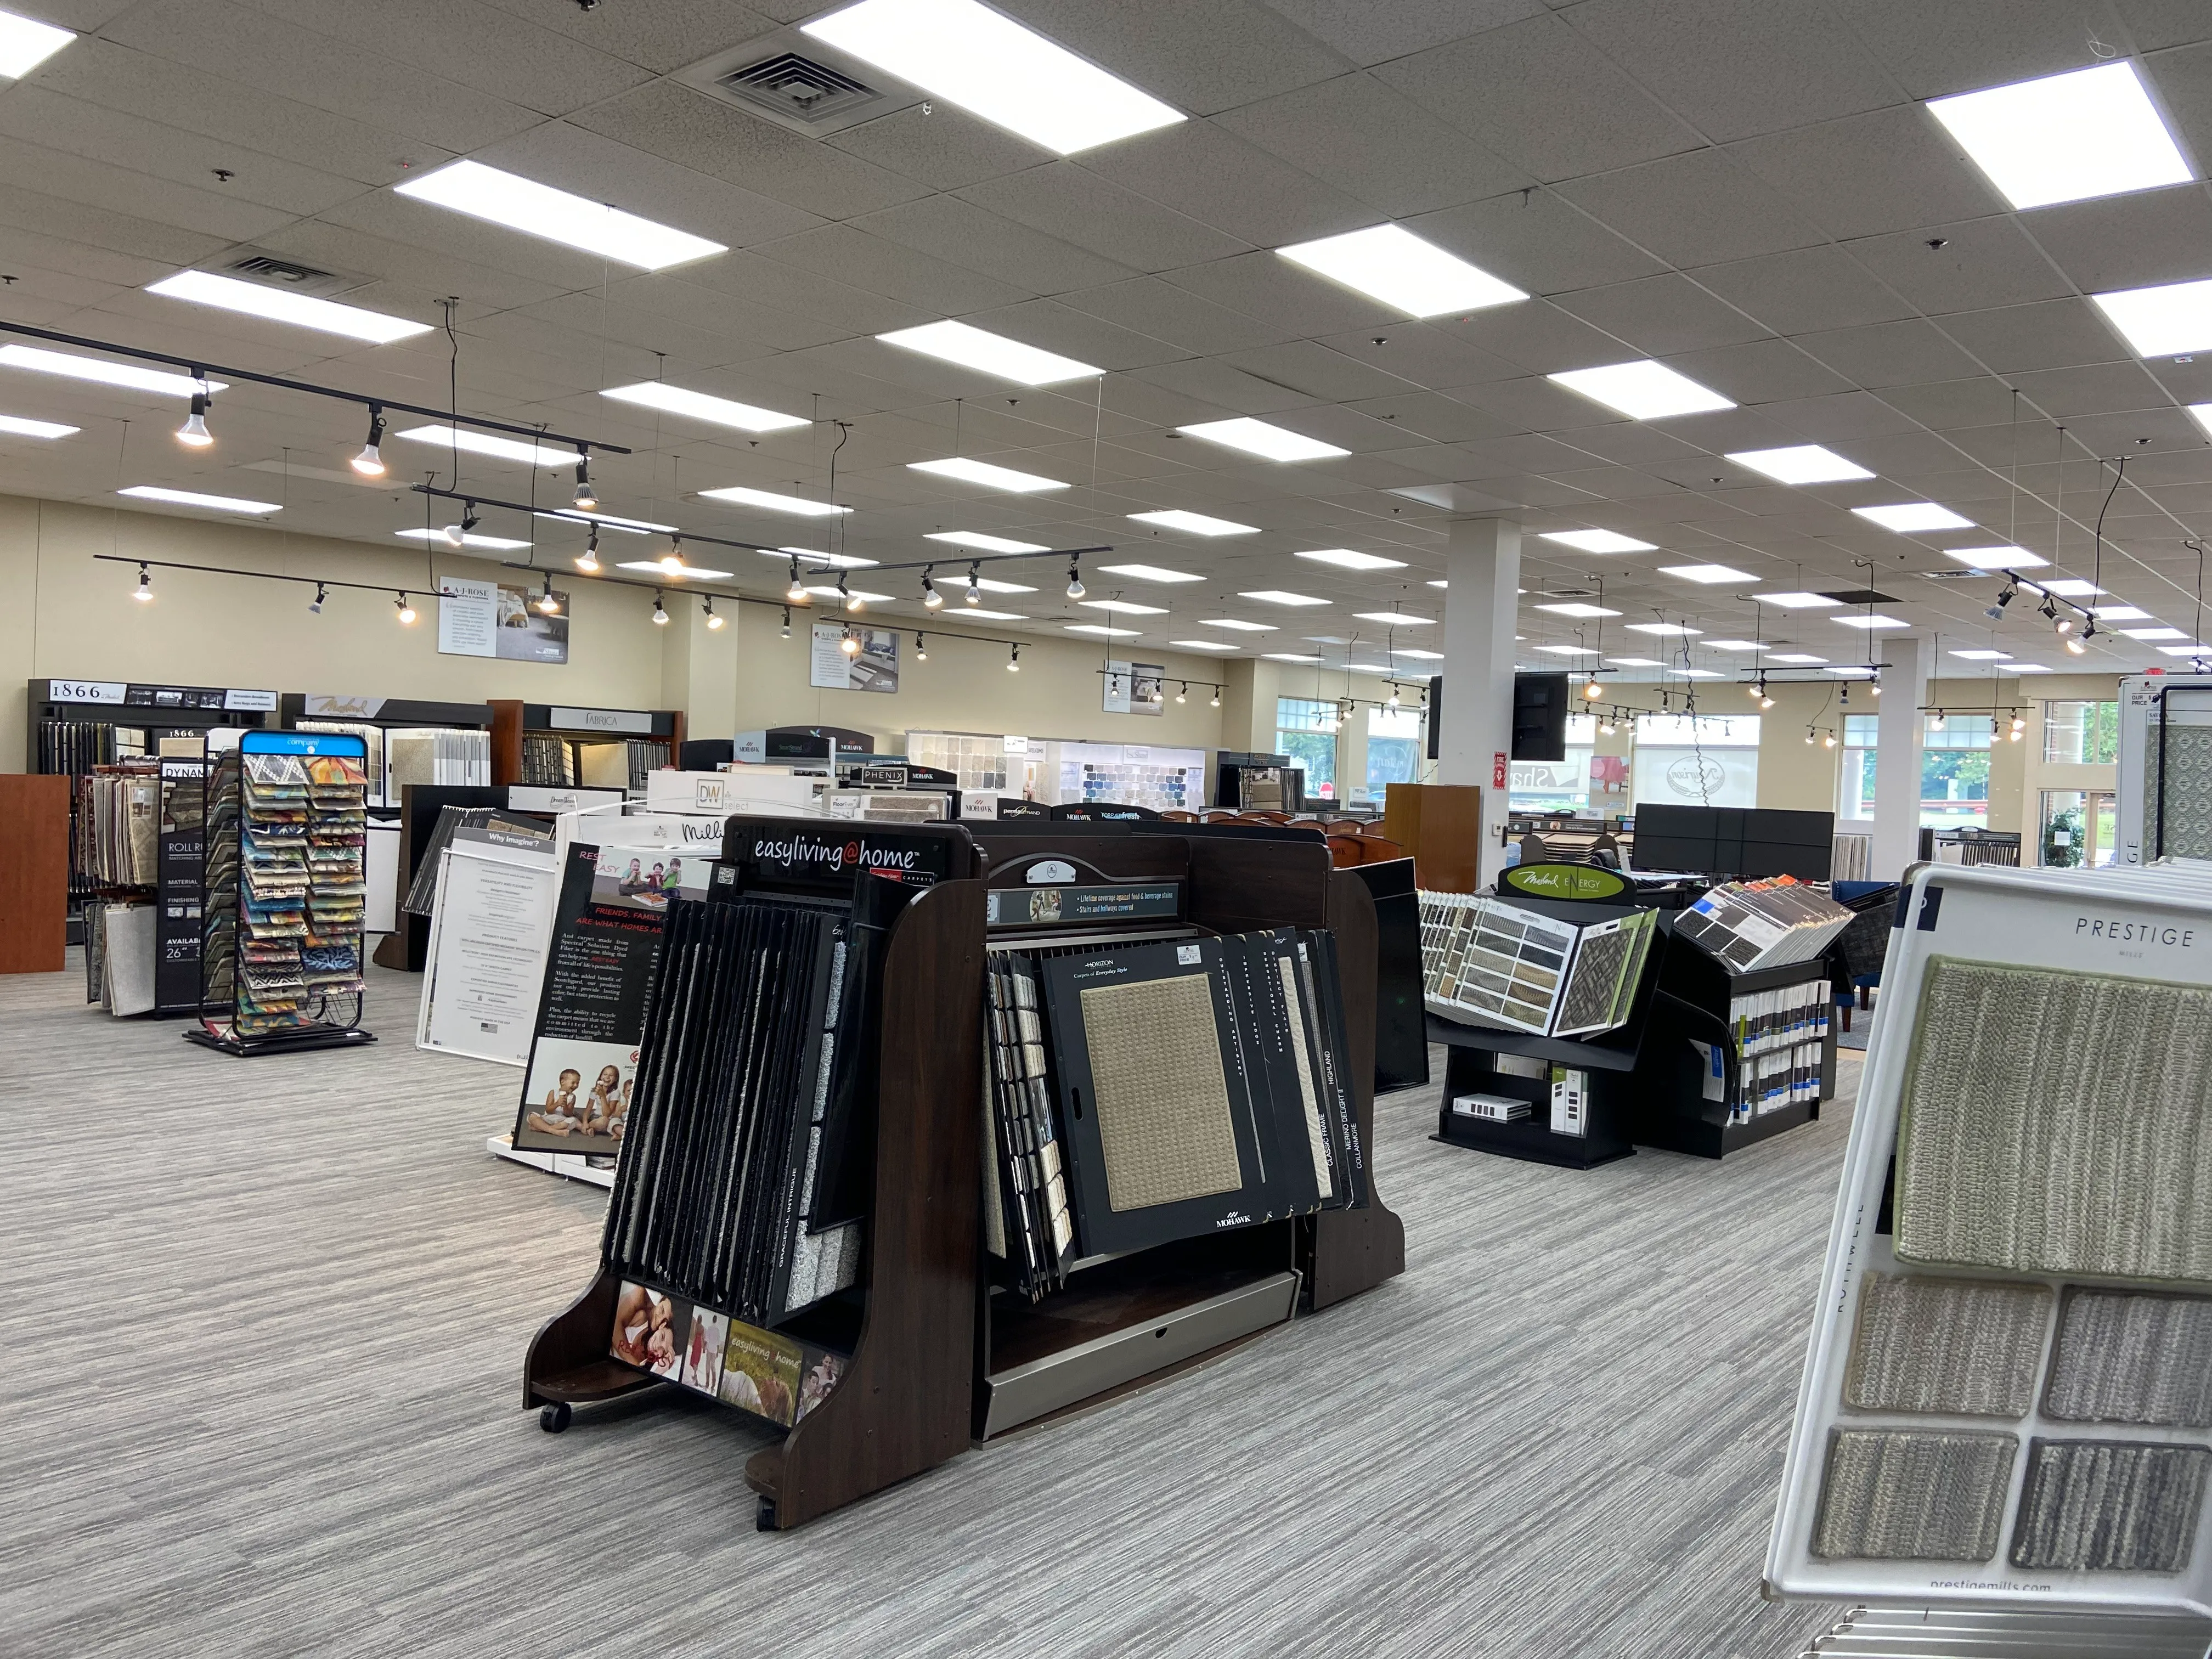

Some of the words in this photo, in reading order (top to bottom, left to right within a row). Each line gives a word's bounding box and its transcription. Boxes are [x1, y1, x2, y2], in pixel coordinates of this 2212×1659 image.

[54, 684, 100, 698] 1866
[586, 713, 617, 726] FABRICA
[865, 771, 902, 780] PHENIX
[700, 786, 720, 803] DW
[725, 800, 748, 810] select
[489, 833, 505, 842] Why
[682, 821, 723, 843] Milli
[169, 843, 192, 851] ROLL
[579, 851, 606, 861] REST
[593, 864, 620, 873] EASY
[1518, 871, 1559, 888] Masland
[1116, 893, 1130, 902] against
[595, 907, 630, 918] FRIENDS,
[634, 912, 662, 921] FAMILY
[621, 923, 649, 932] HOMES
[2076, 918, 2193, 947] PRESTIGE
[1085, 960, 1114, 968] HORIZON
[1096, 968, 1116, 977] Everyday
[1272, 951, 1282, 996] DISTINCT
[1243, 956, 1254, 1014] IMPRESSIVE
[1263, 952, 1277, 1015] SENSATIONAL
[1219, 958, 1233, 1022] OUTSTANDING
[1232, 1030, 1242, 1076] ARTISTRY
[1324, 1051, 1334, 1085] HIGHLAND
[1339, 1094, 1348, 1122] DELIGHT
[1319, 1113, 1328, 1136] FRAME
[1344, 1124, 1352, 1150] MERINO
[1323, 1137, 1333, 1166] CLASSIC
[1351, 1123, 1362, 1169] COLLANMORE
[779, 1214, 790, 1267] GRACEFUL
[787, 1167, 797, 1212] INTRIGUE
[1217, 1215, 1251, 1228] MOHAWK
[1931, 1580, 2051, 1591] prestigemillscom
